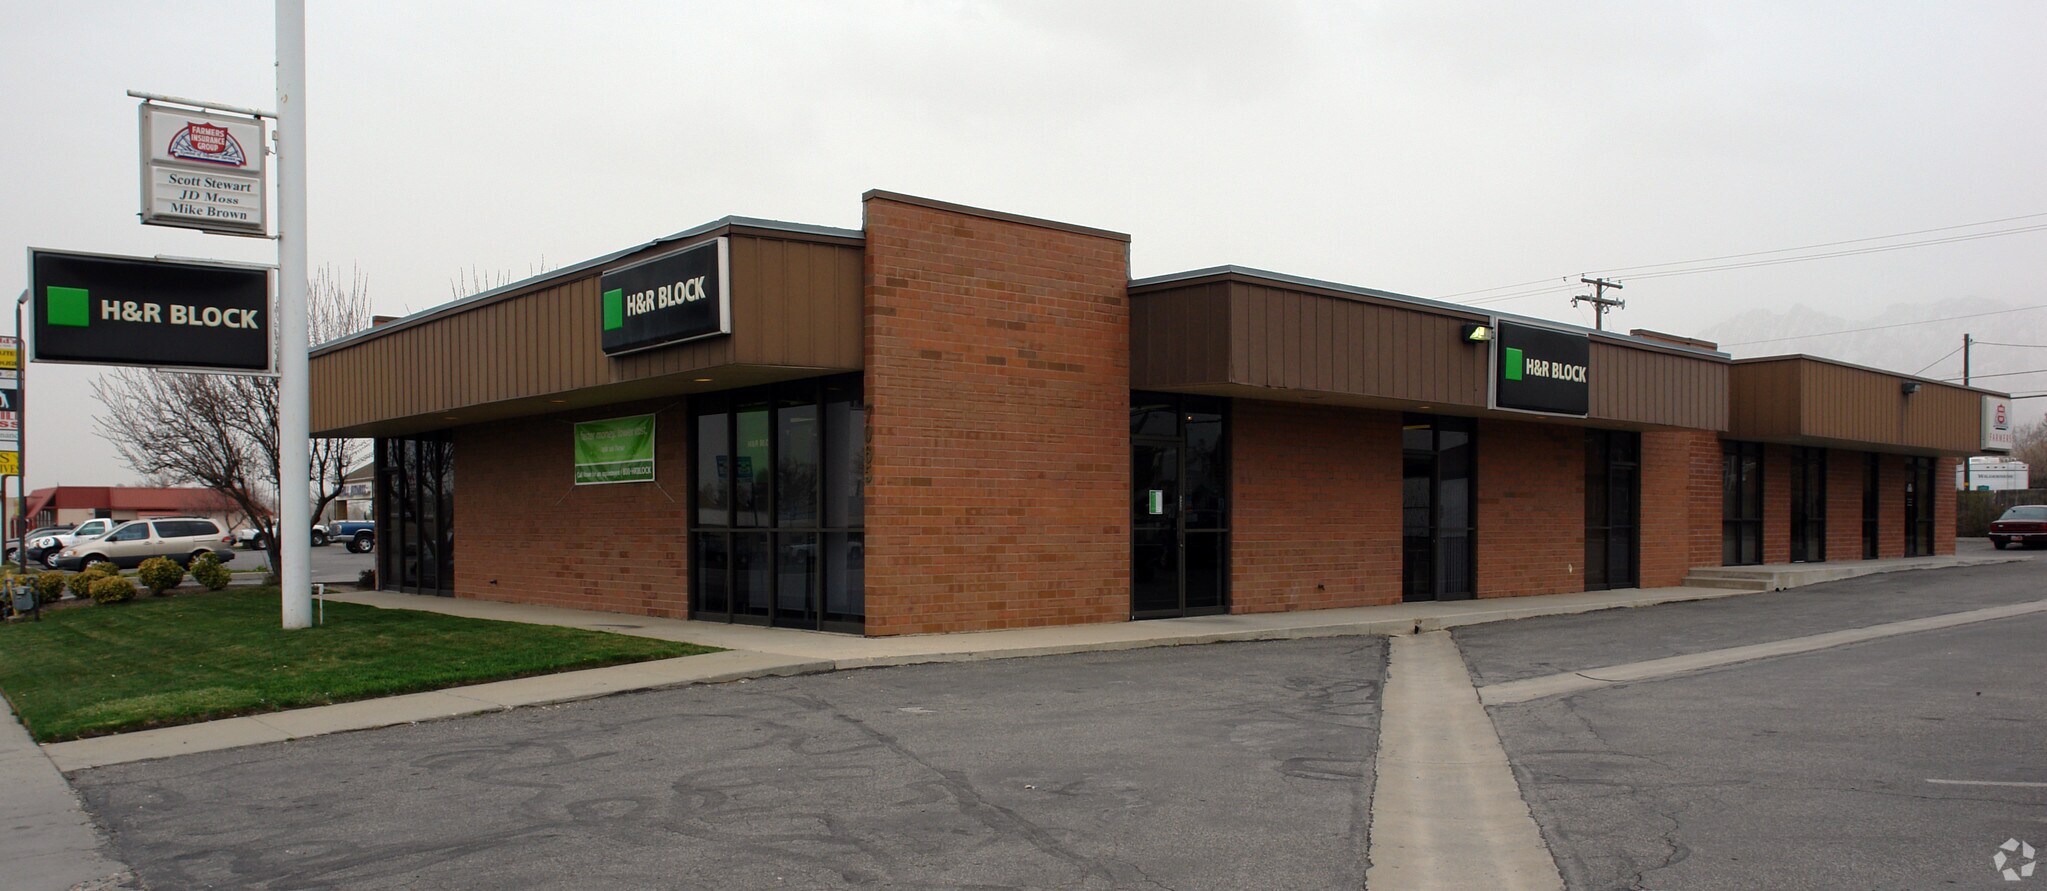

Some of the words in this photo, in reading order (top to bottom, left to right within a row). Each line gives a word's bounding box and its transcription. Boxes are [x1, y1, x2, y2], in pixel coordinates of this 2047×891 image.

[191, 134, 225, 145] INSURANCE
[192, 126, 224, 137] FARMERS
[197, 142, 218, 152] GROUP
[169, 173, 201, 187] Scott
[204, 178, 252, 192] Stewart
[179, 190, 200, 200] JD
[204, 192, 239, 205] Moss
[170, 202, 203, 215] Mike
[207, 206, 247, 220] Brown
[627, 289, 656, 317] H&R
[658, 275, 706, 309] BLOCK
[101, 299, 162, 323] H&R
[170, 304, 259, 330] BLOCK
[1526, 358, 1550, 378] H&R
[1551, 362, 1587, 383] BLOCK
[1989, 432, 2013, 443] FARMERS
